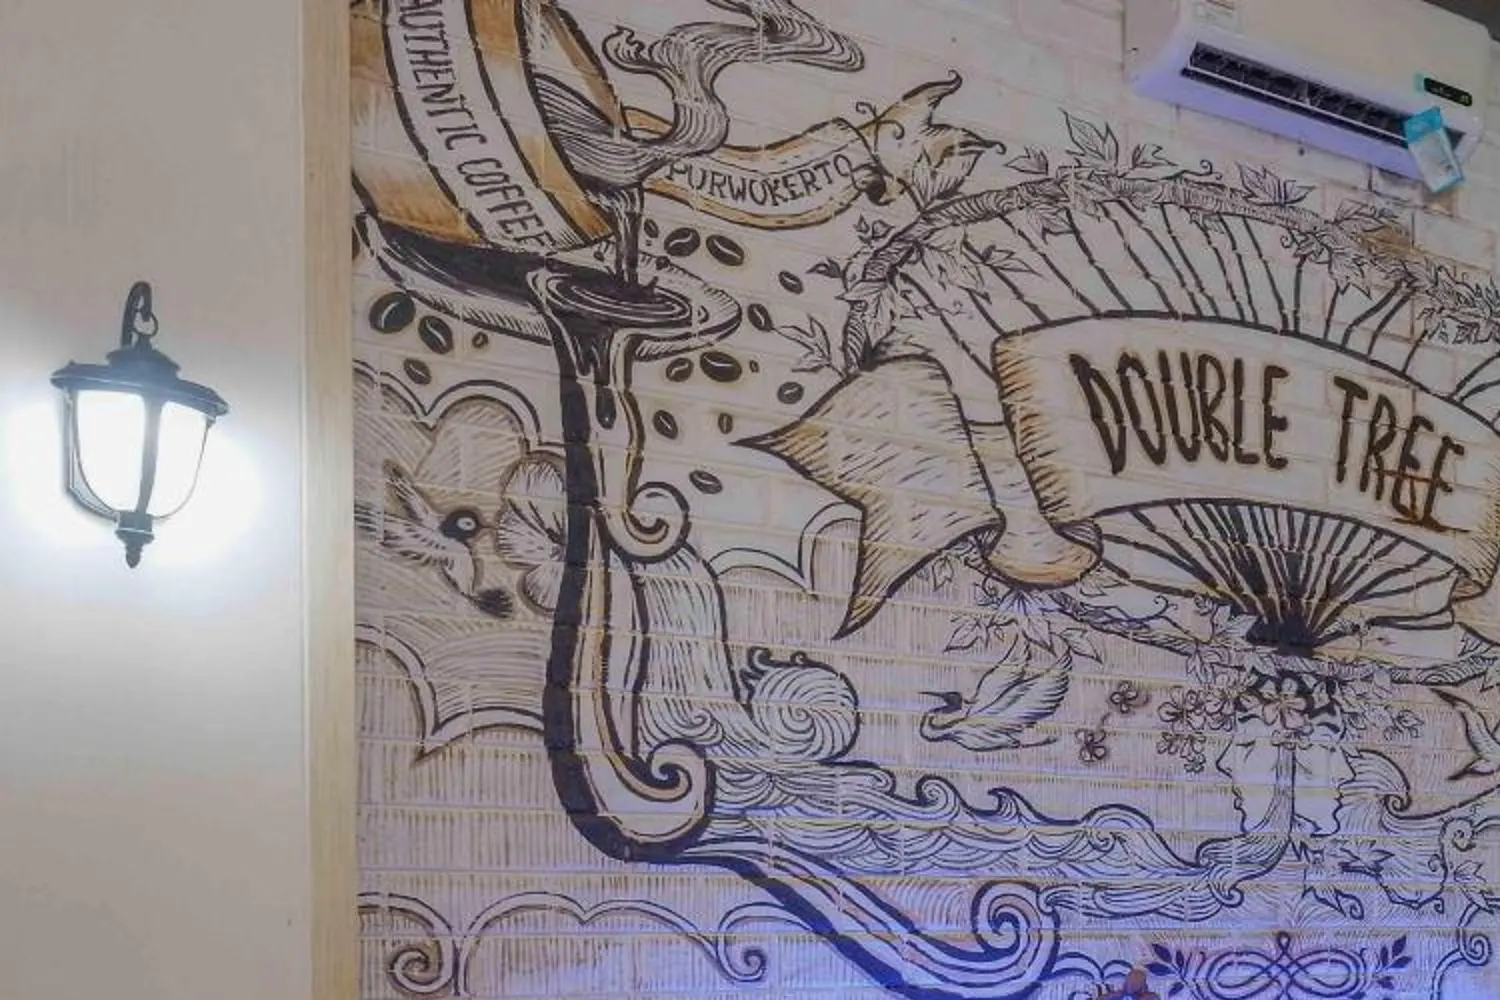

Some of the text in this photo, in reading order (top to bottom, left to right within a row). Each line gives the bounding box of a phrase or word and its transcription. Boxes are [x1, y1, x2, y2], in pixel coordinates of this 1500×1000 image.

[398, 0, 558, 257] AUTHENTIC COFFEE
[665, 153, 852, 207] PURWOKERTO
[1068, 350, 1468, 532] DOUBLE TREE
